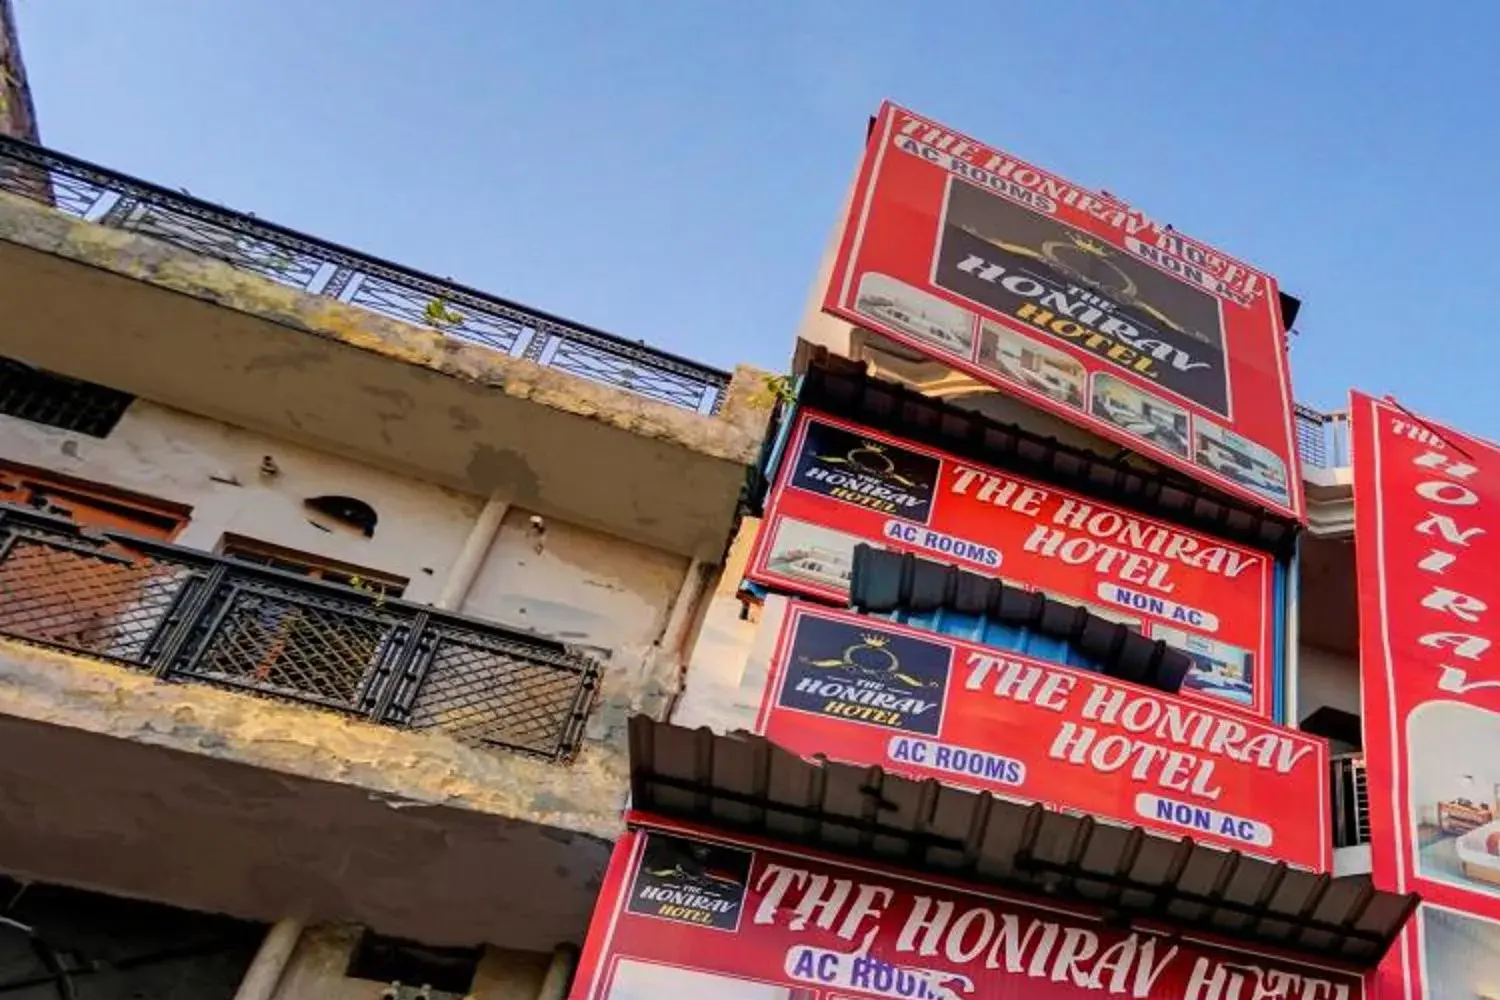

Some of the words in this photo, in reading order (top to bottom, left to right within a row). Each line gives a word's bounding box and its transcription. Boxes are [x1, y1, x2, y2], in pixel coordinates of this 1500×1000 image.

[899, 116, 981, 160] THE
[903, 139, 939, 162] AC
[951, 158, 1052, 212] ROOMS
[956, 254, 1211, 371] HONIRAV
[1015, 302, 1160, 378] HOTEL
[1391, 418, 1447, 450] THE
[805, 467, 927, 507] HONIRAV
[952, 465, 1047, 516] THE
[1052, 499, 1259, 578] HONIRAV
[888, 523, 918, 544] AC
[925, 531, 999, 567] ROOMS
[1023, 523, 1176, 593] HOTEL
[1116, 588, 1164, 615] NON
[1173, 607, 1203, 626] AC
[796, 677, 937, 715] HONIRAV
[823, 701, 903, 726] HOTEL
[964, 651, 1077, 713] THE
[1081, 684, 1314, 774] HONIRAV
[893, 738, 930, 766] AC
[935, 745, 1021, 784] ROOMS
[1048, 720, 1222, 801] HOTEL
[1156, 799, 1211, 832] NON
[1215, 813, 1255, 842] AC
[640, 886, 738, 913] HONIRAV
[756, 864, 894, 942] THE
[896, 895, 1178, 998] HONIRAV
[794, 950, 838, 982] AC
